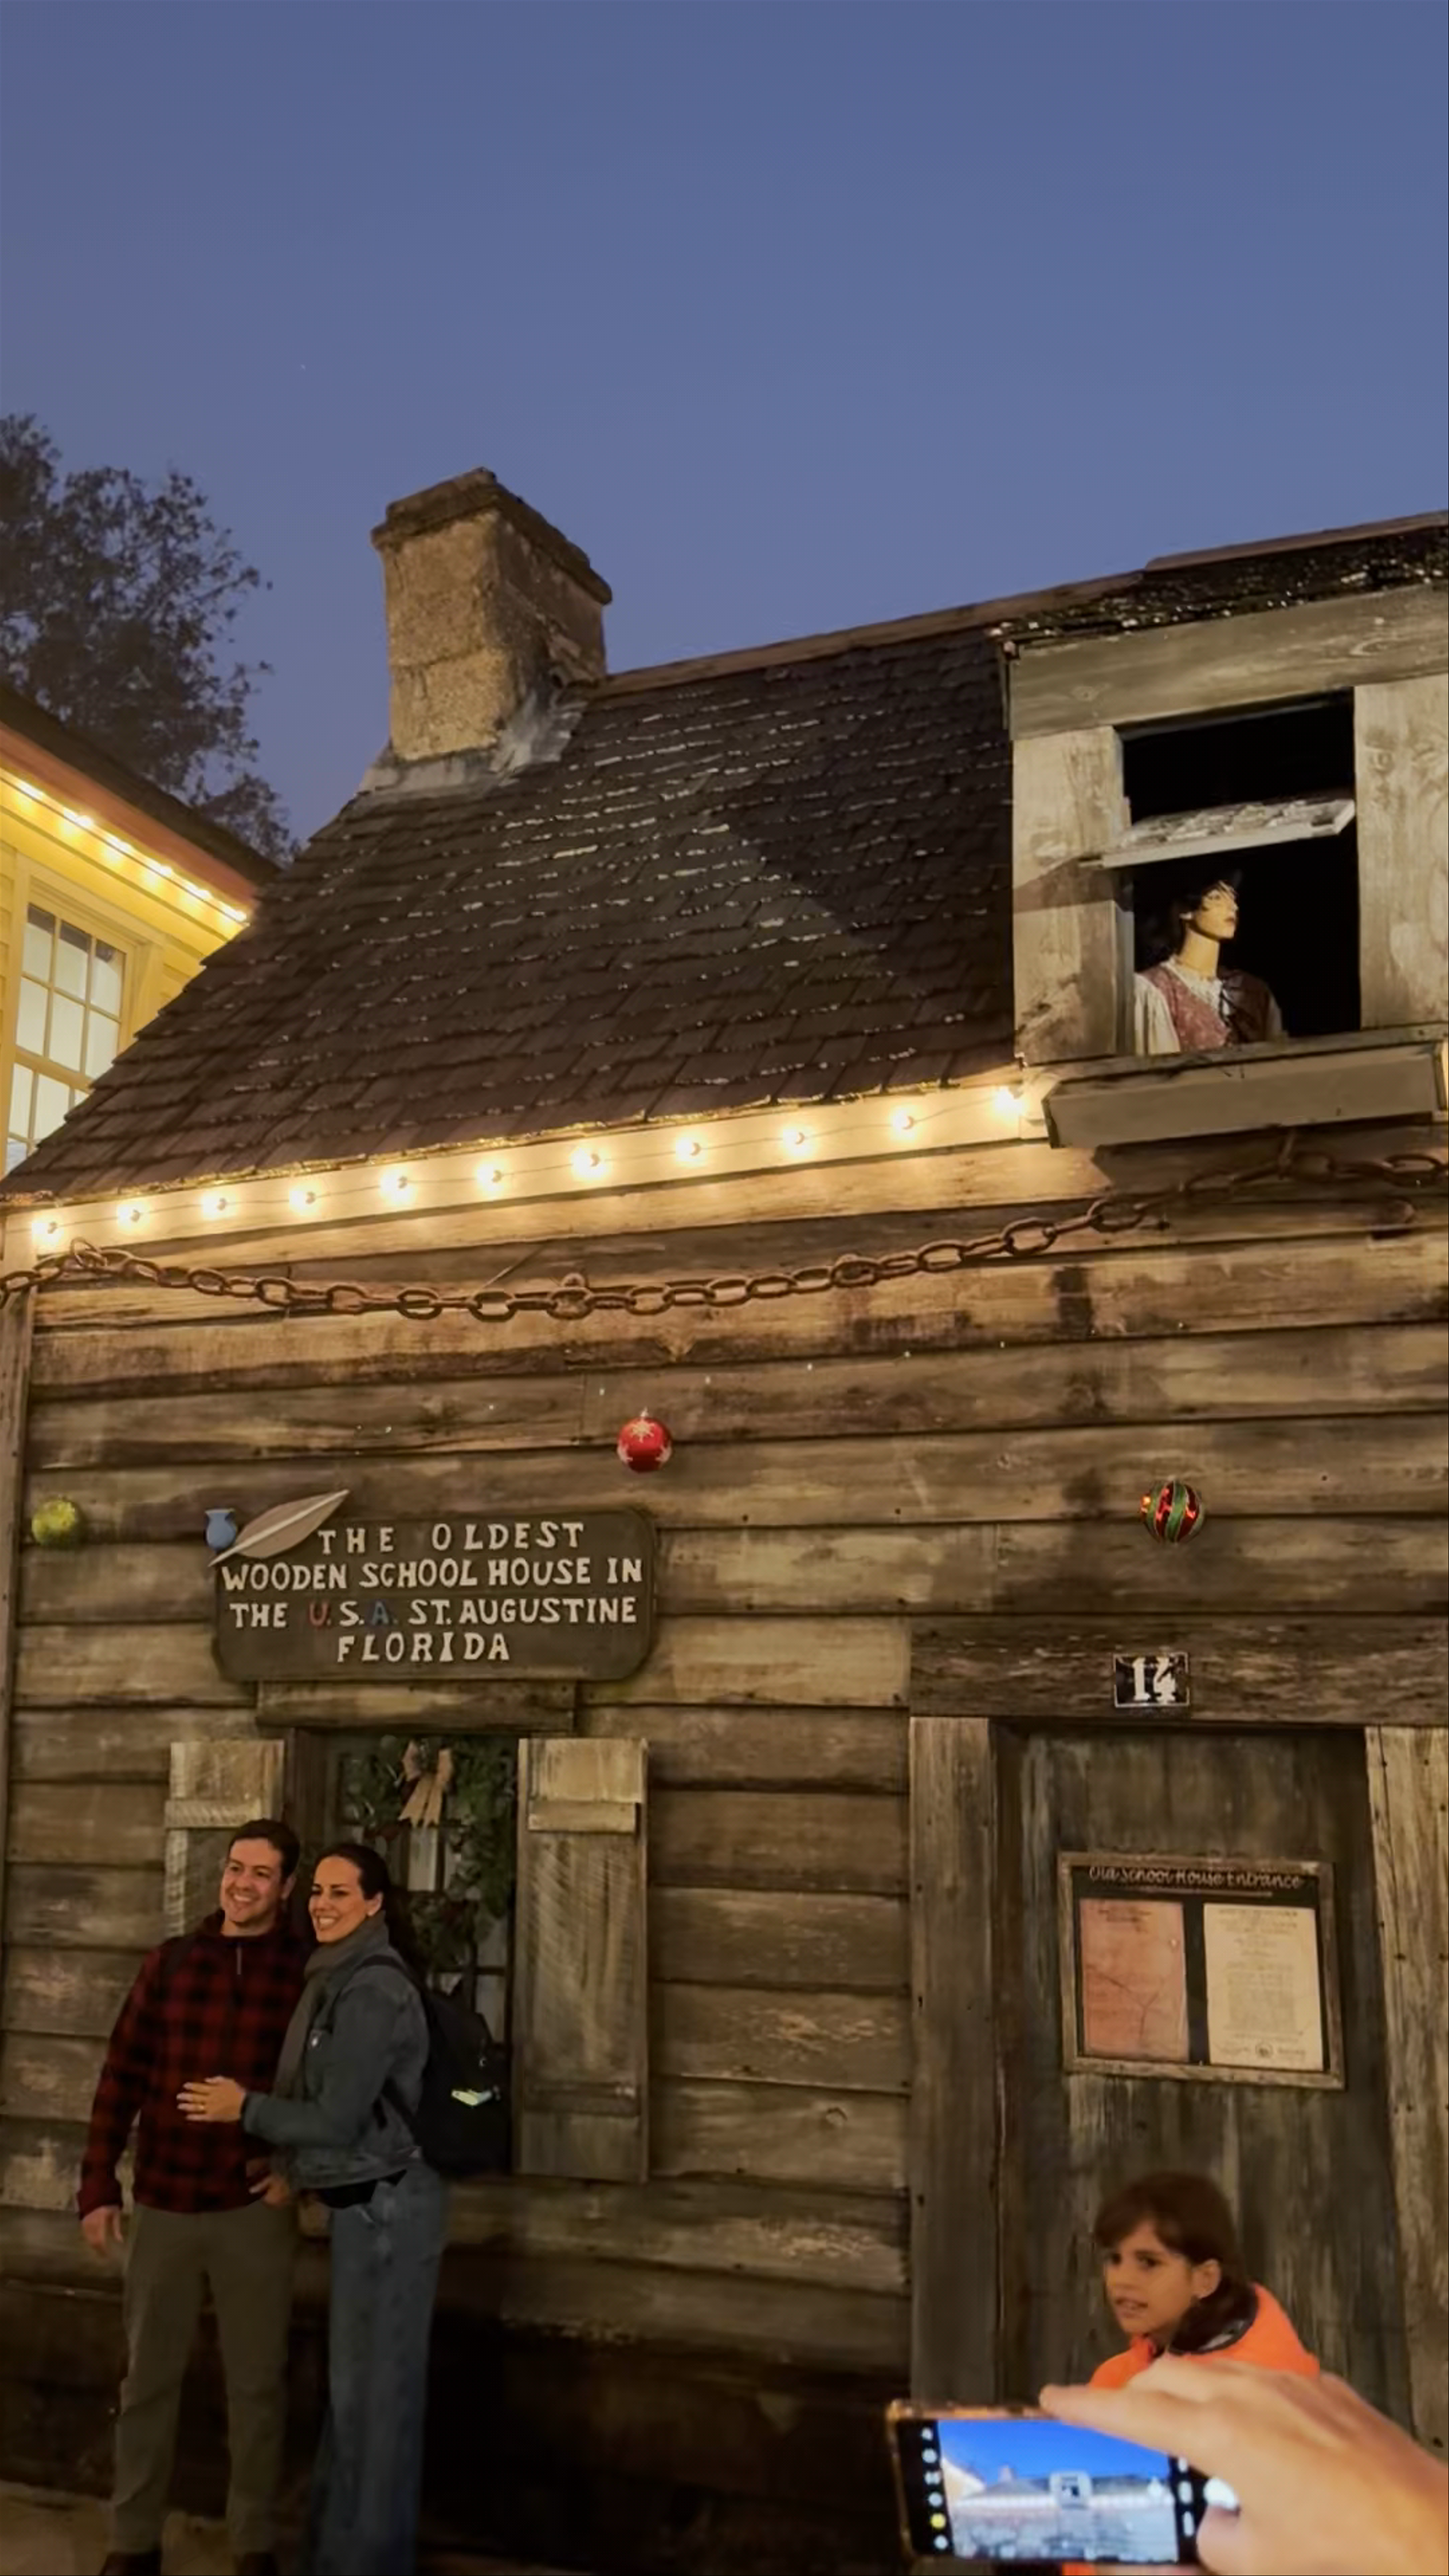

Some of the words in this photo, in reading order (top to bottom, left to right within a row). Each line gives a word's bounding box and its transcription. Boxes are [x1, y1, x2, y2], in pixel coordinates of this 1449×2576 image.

[318, 1527, 394, 1555] THE
[432, 1521, 585, 1552] OLDEST
[221, 1562, 347, 1591] WOODEN
[358, 1558, 478, 1588] SCHOOL
[488, 1557, 591, 1587] HOUSE
[606, 1558, 643, 1583] IN
[229, 1601, 288, 1628] THE
[459, 1597, 637, 1625] AUGUSTINE
[337, 1632, 510, 1663] FLORIDA
